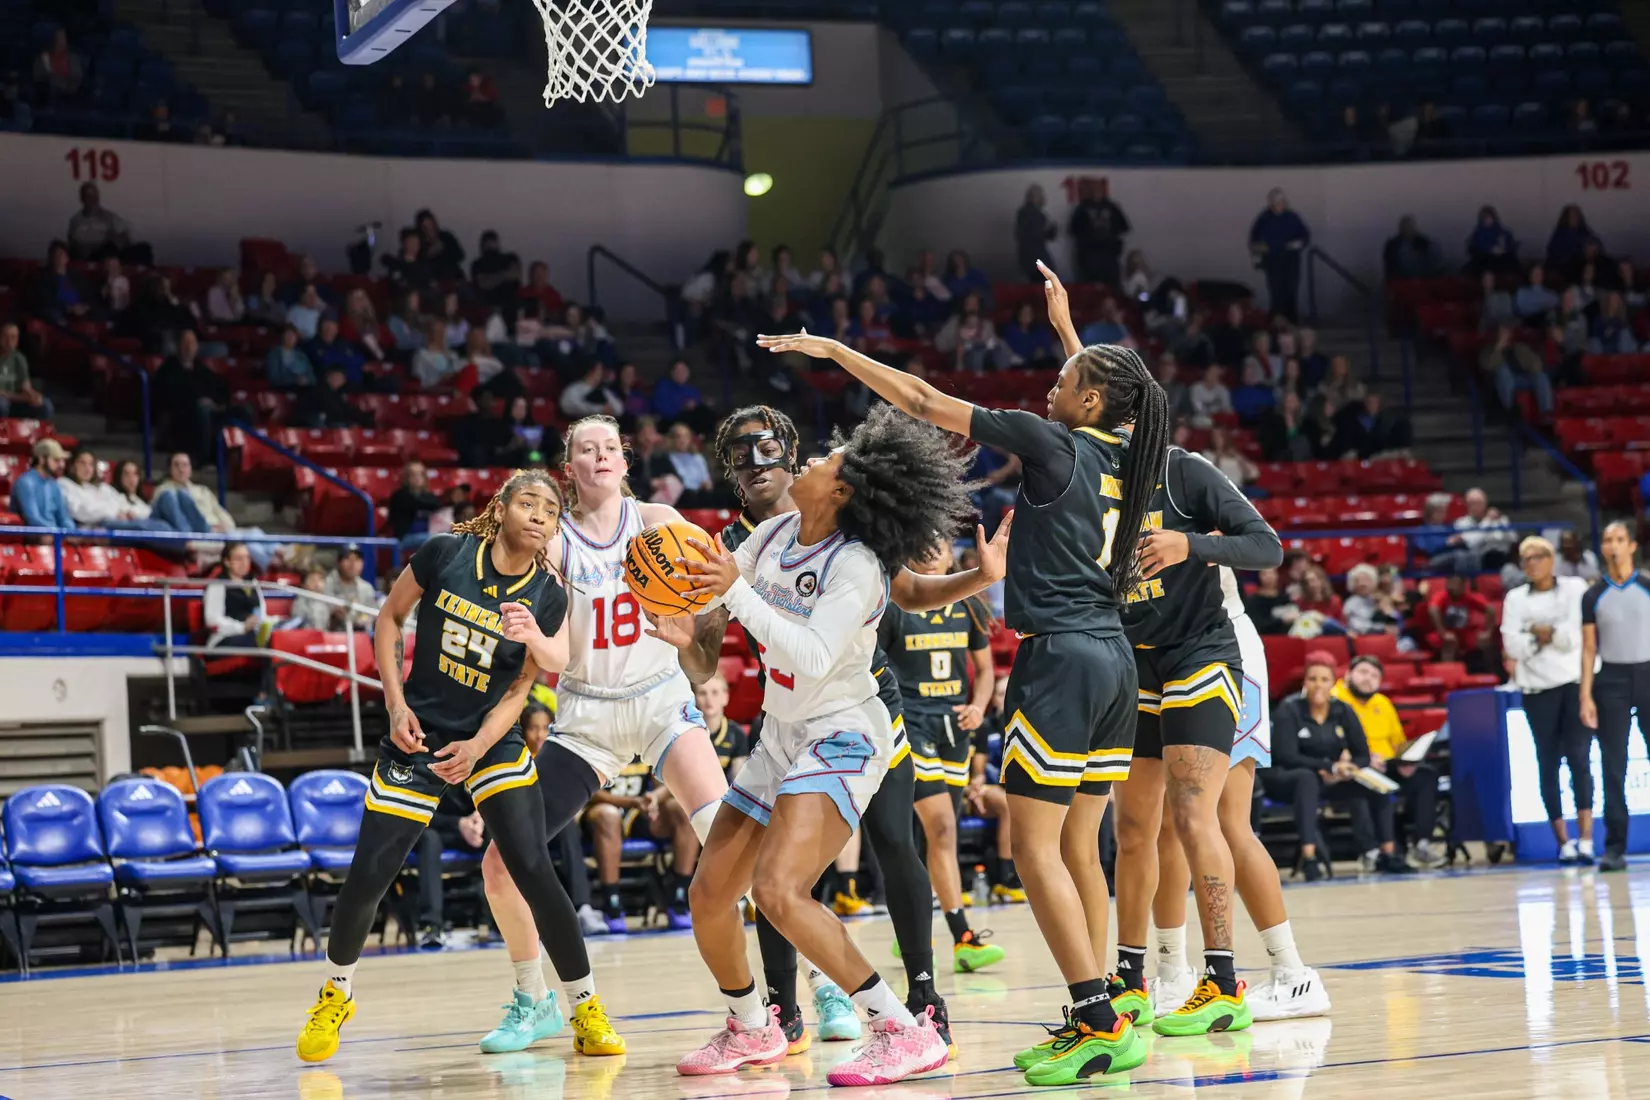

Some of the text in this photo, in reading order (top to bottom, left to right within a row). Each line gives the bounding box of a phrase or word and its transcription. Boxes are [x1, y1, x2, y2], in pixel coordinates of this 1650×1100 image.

[64, 147, 120, 182] 119
[1574, 160, 1631, 190] 102
[641, 527, 675, 577] Wilson
[592, 592, 641, 649] 18
[441, 617, 499, 669] 24
[905, 631, 969, 652] KENNESAW
[438, 653, 491, 693] STATE
[929, 650, 952, 680] 0
[918, 680, 962, 697] STATE
